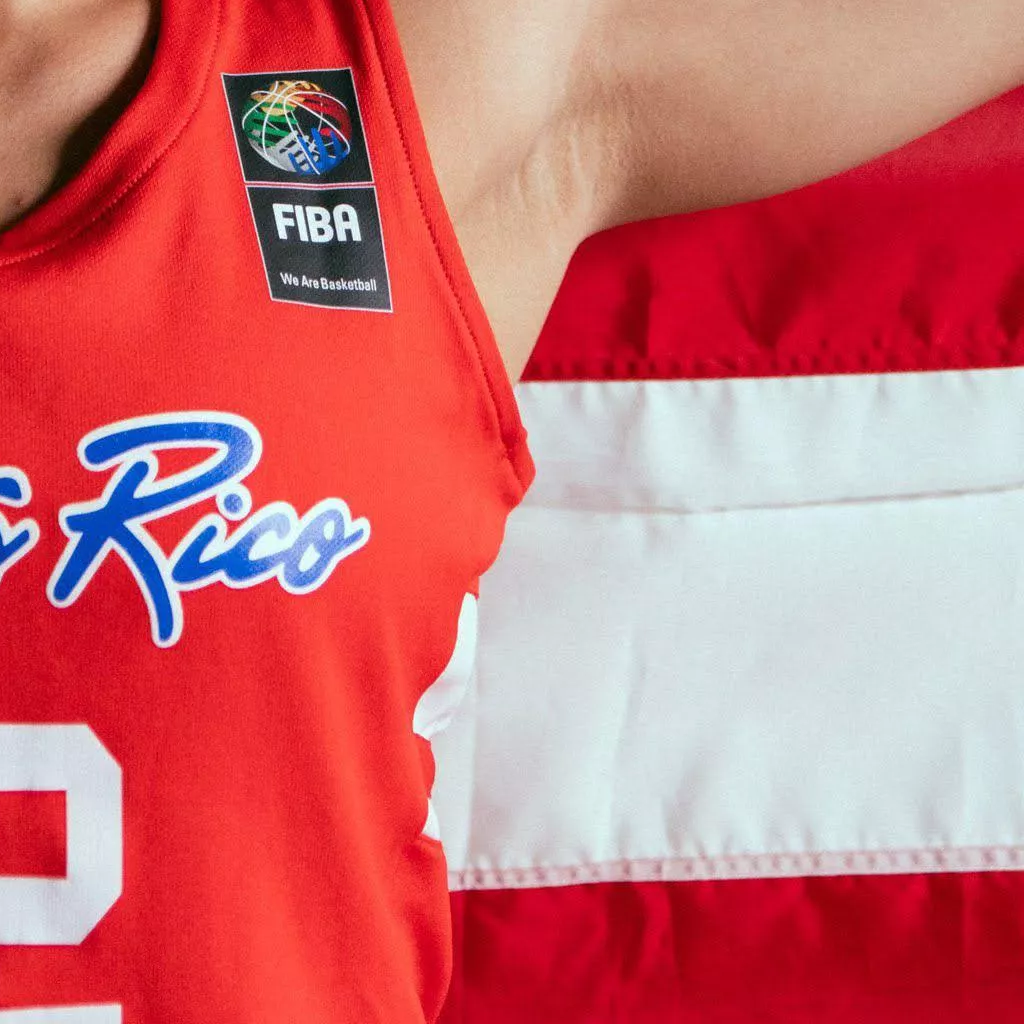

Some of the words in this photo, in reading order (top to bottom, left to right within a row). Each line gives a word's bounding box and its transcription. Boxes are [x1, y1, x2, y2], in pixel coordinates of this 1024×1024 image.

[272, 203, 362, 243] FIBA
[280, 272, 299, 286] We
[301, 275, 320, 289] Are
[320, 277, 377, 291] Basketball
[46, 411, 371, 646] Rico
